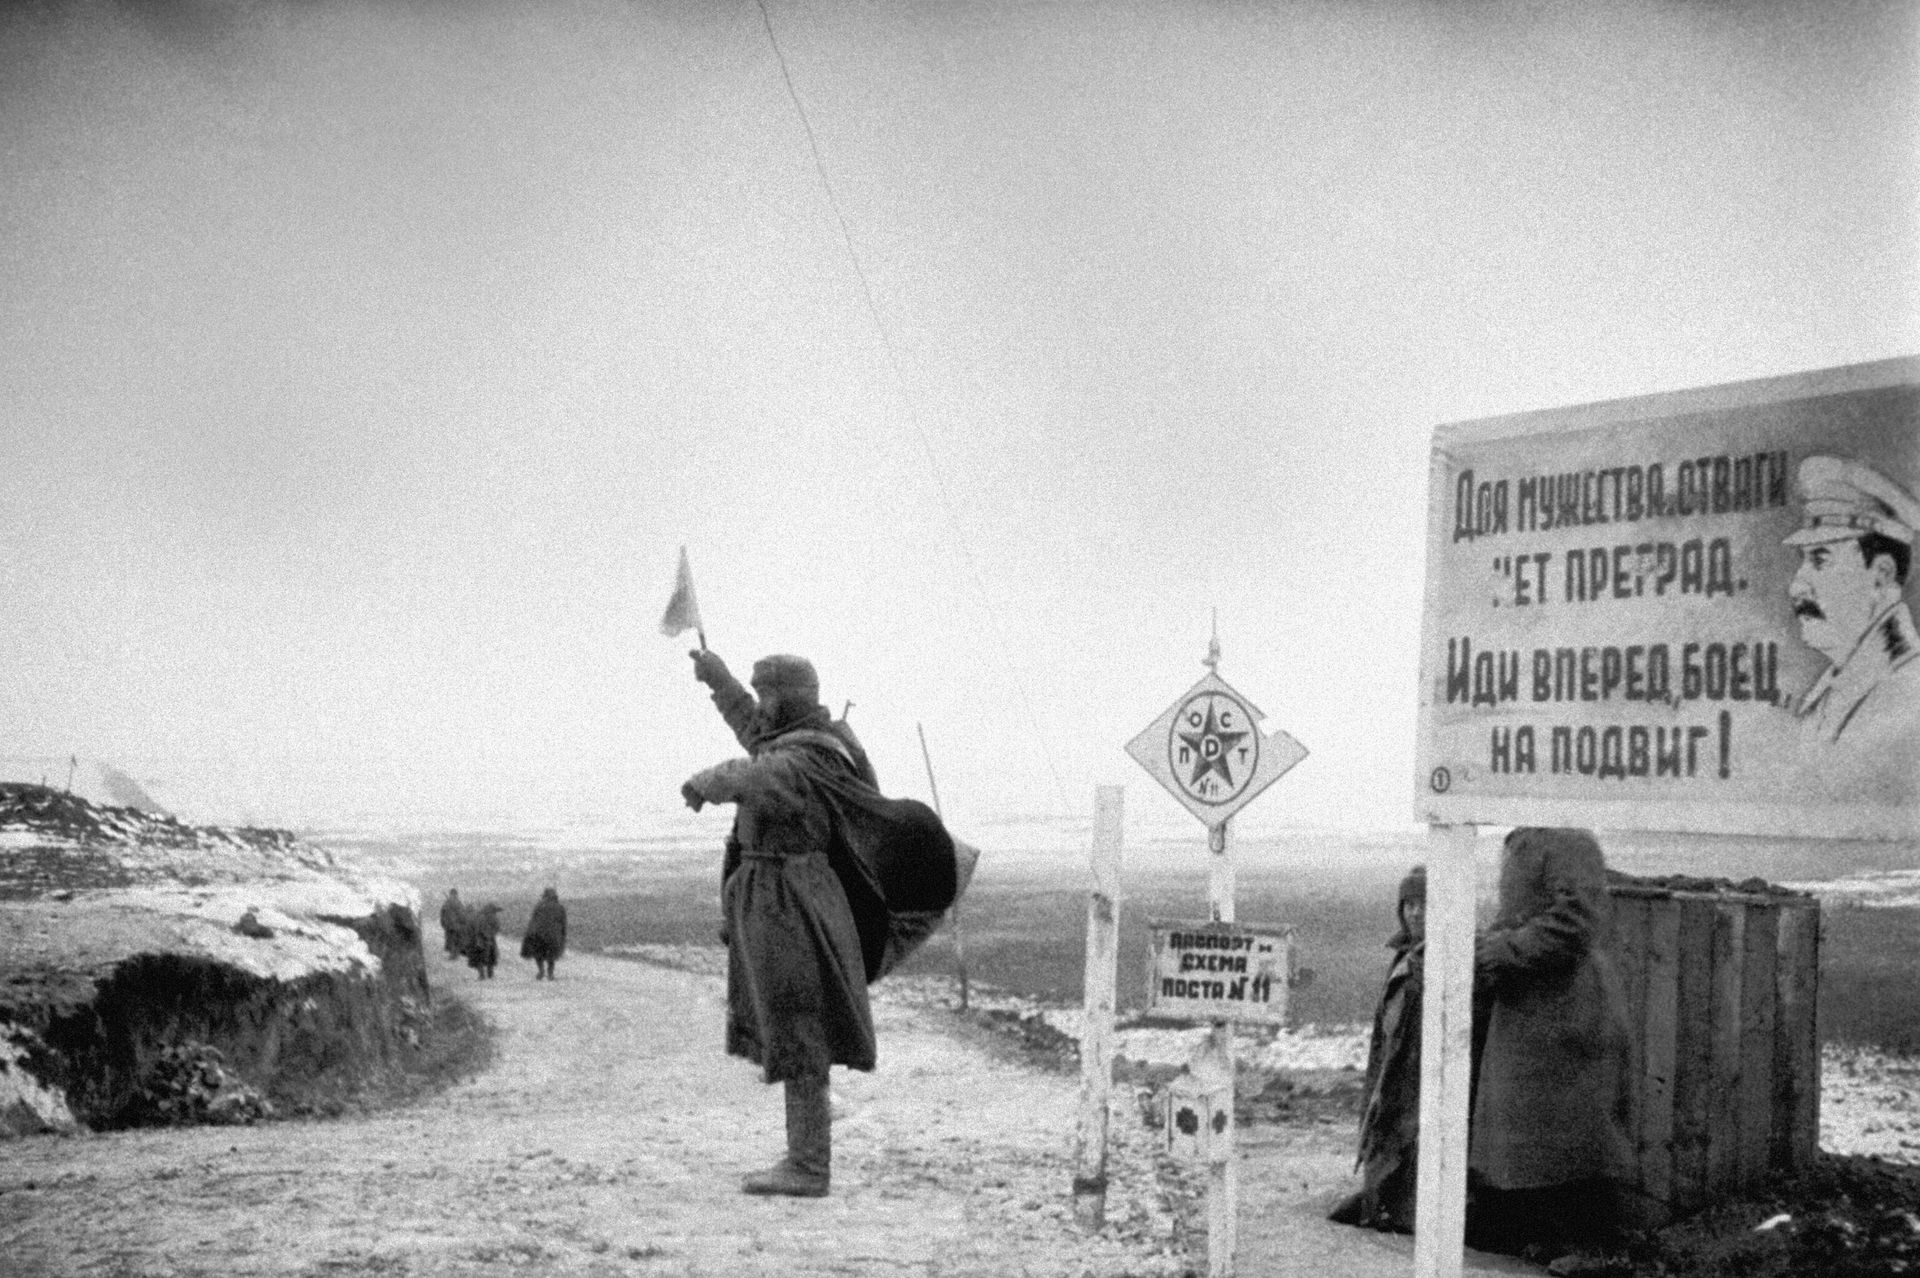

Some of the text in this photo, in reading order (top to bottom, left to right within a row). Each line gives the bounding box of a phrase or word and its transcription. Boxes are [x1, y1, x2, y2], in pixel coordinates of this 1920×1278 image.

[1446, 635, 1519, 708] ИДИ
[1491, 709, 1731, 781] НА ПОДВИГ!
[1181, 952, 1248, 974] СХЕМА
[1161, 976, 1225, 1000] ПОСТА
